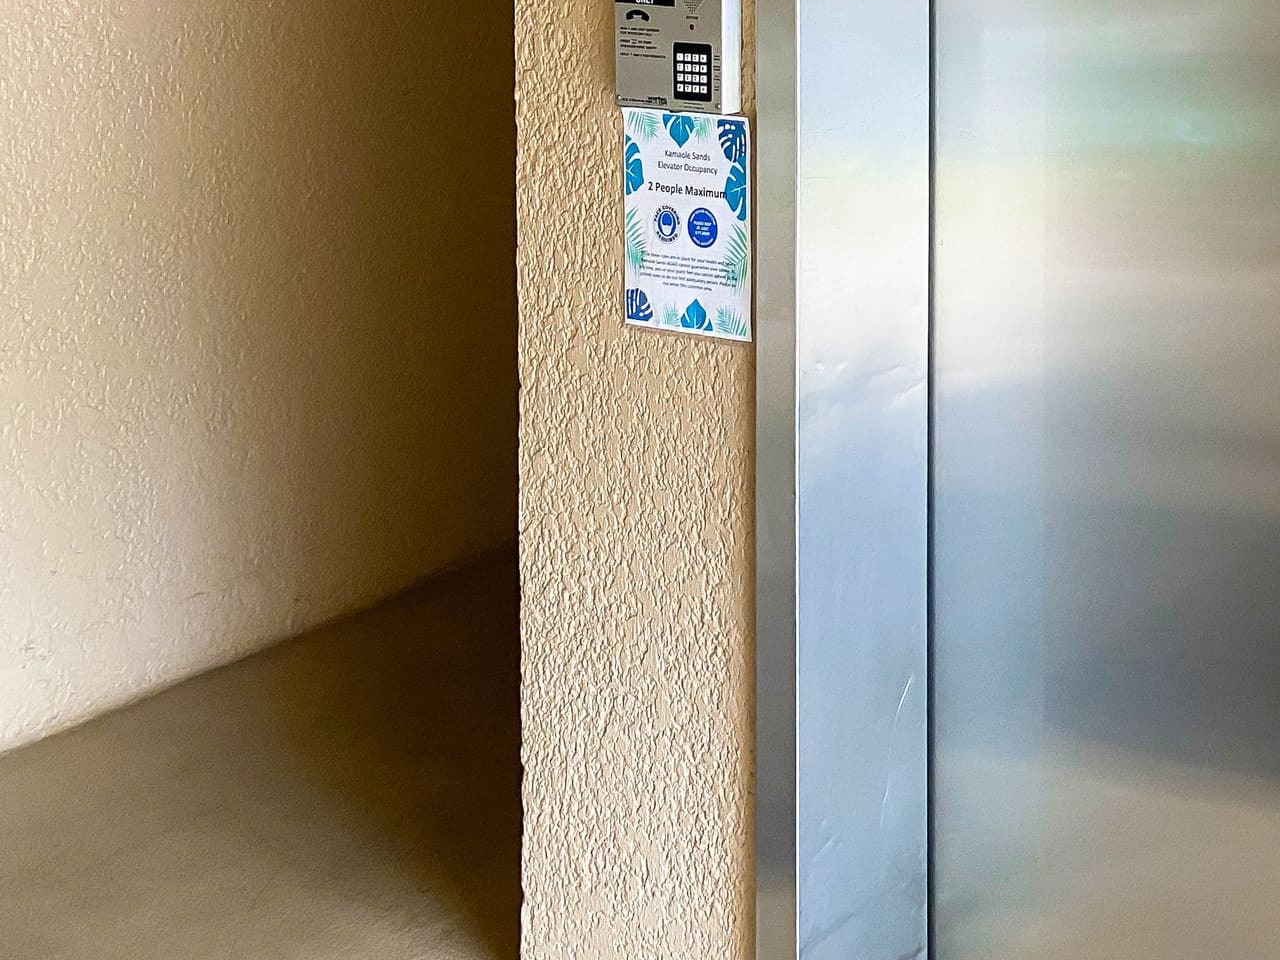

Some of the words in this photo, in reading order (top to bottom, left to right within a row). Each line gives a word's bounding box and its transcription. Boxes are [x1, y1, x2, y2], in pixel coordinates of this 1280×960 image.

[692, 151, 710, 161] Sands
[658, 161, 683, 171] Elevator
[684, 164, 718, 176] Occupancy
[648, 181, 653, 191] 2
[655, 182, 683, 195] People
[685, 186, 727, 199] Maximum
